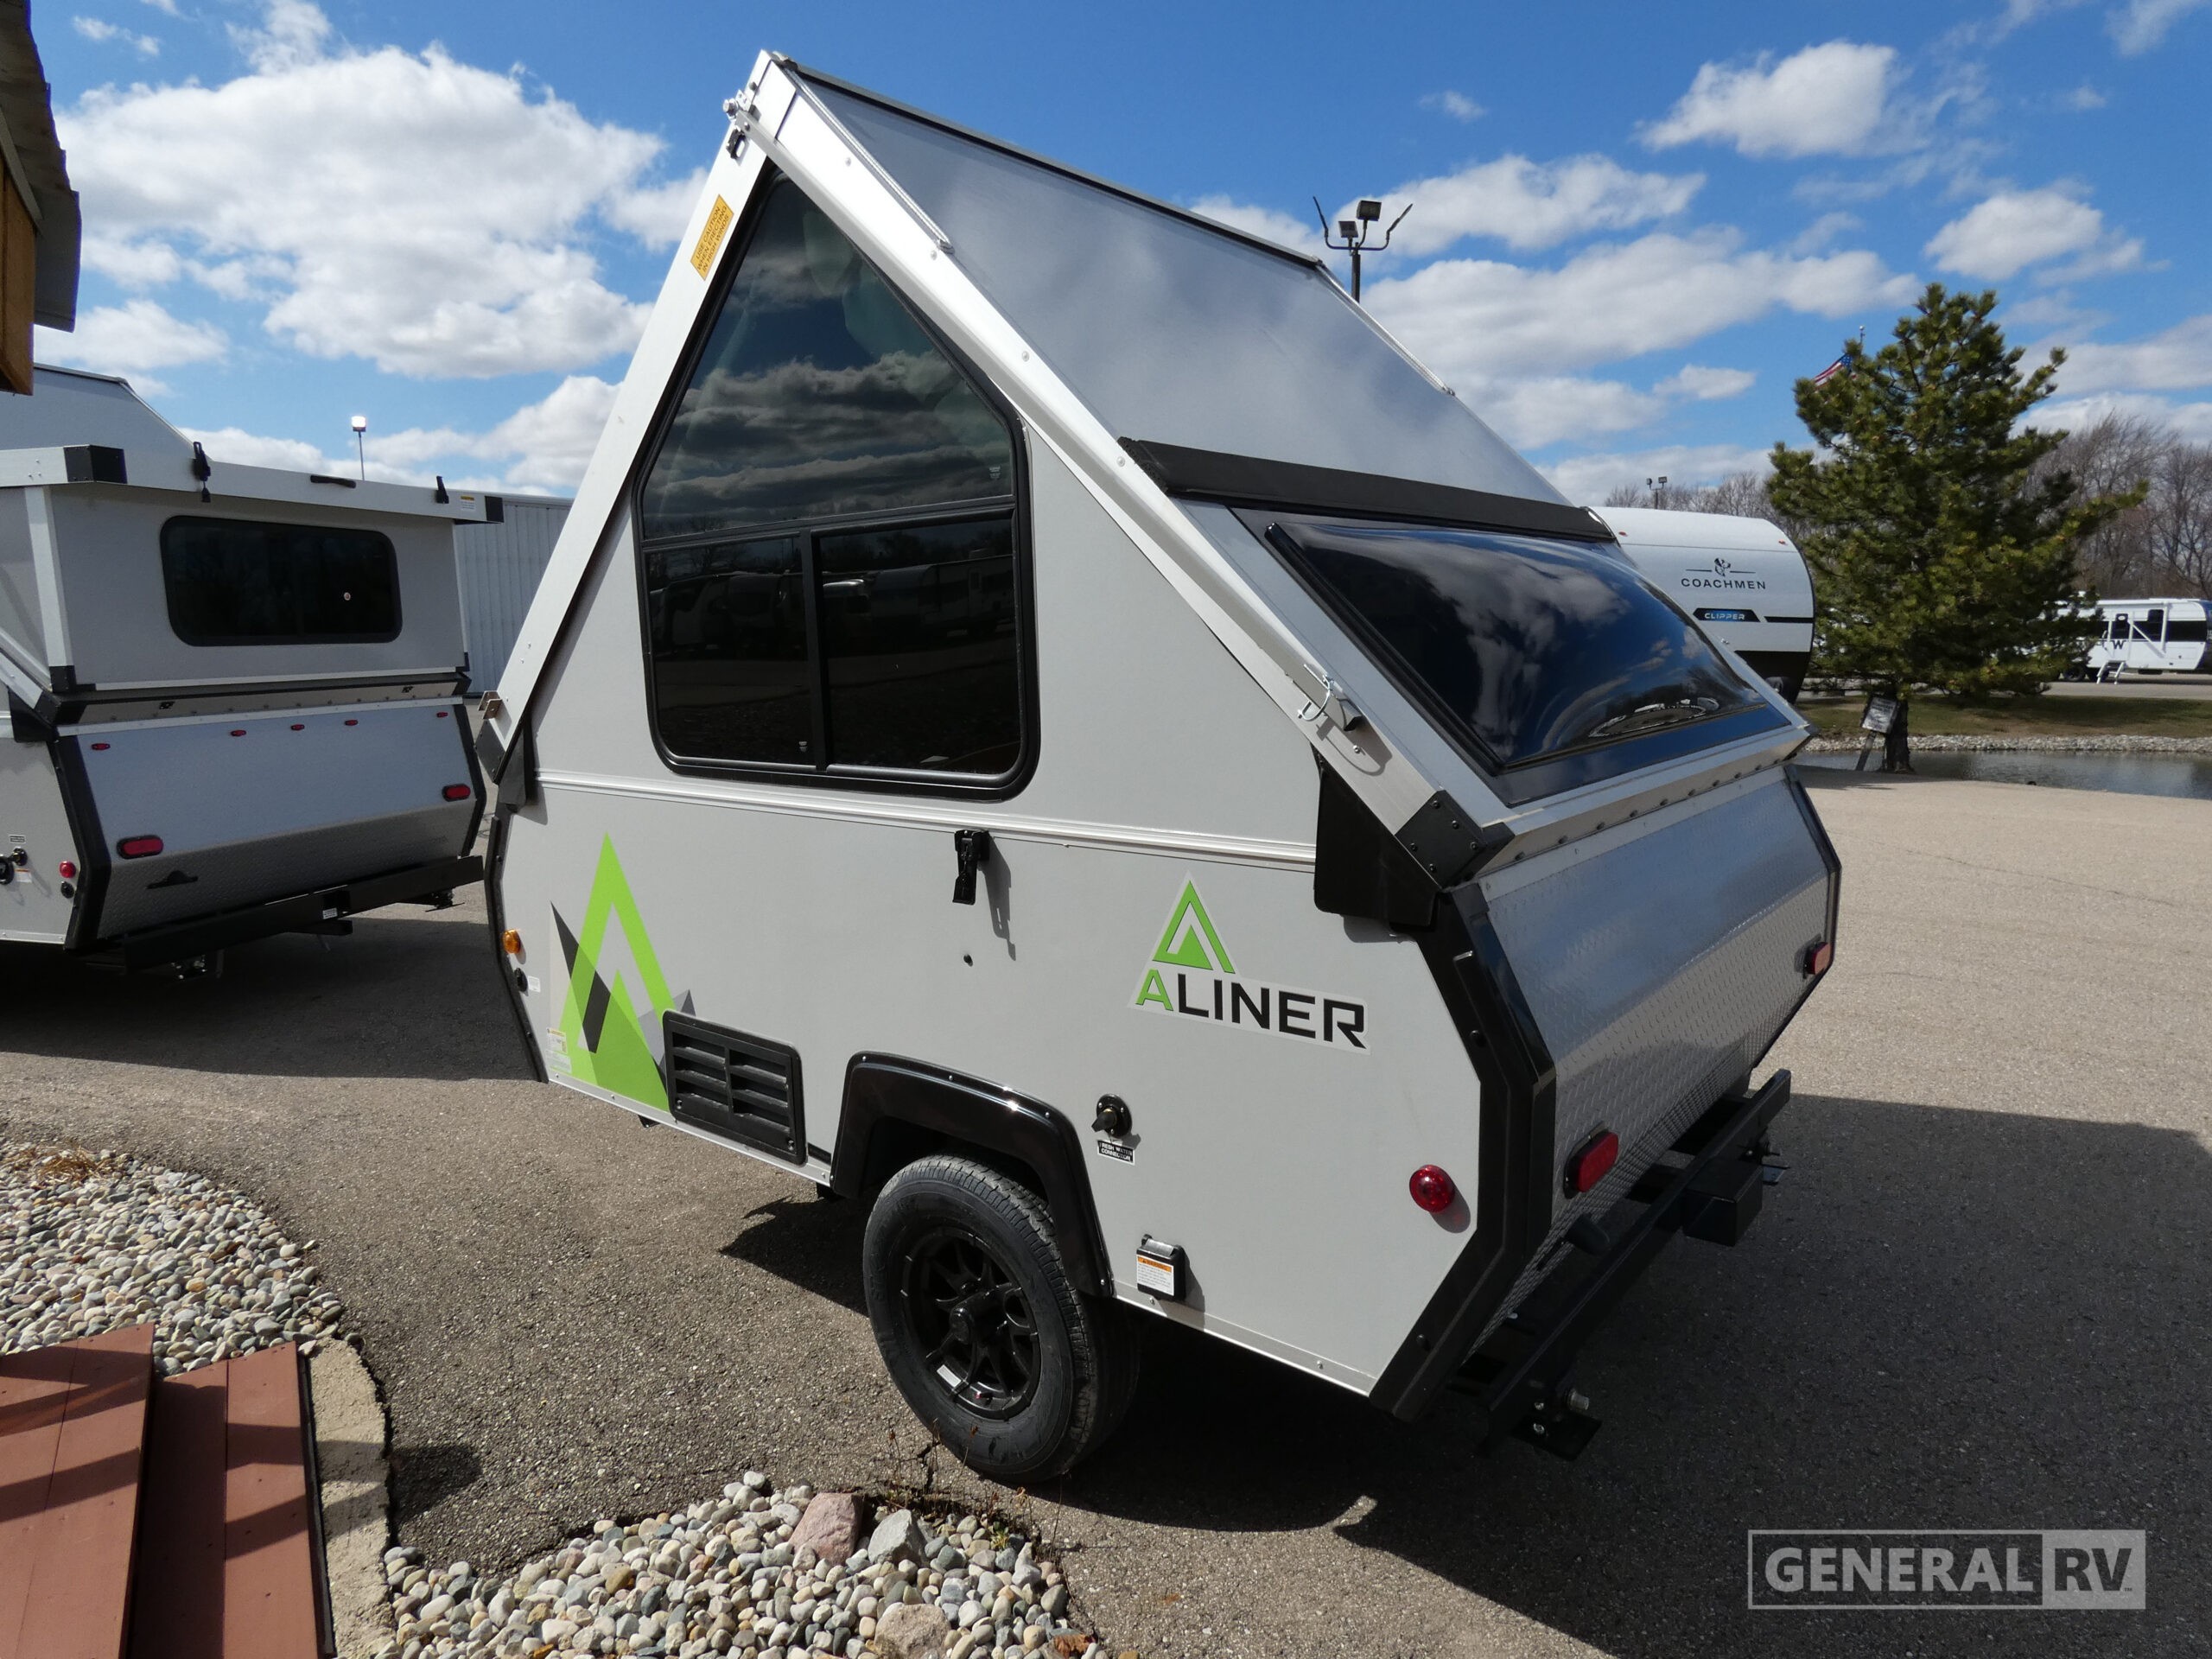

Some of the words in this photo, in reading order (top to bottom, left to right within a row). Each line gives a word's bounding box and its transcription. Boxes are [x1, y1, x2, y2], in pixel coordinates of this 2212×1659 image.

[696, 243, 704, 260] USE
[703, 207, 720, 243] CAUTION
[696, 247, 709, 270] WHEN
[708, 206, 727, 246] ERECTING
[702, 262, 709, 272] IN
[708, 242, 717, 264] HIGH
[715, 215, 729, 242] WINDS
[1681, 578, 1766, 589] COACHMEN
[1135, 969, 1367, 1050] ALINER
[1101, 1148, 1131, 1161] CONNECTION
